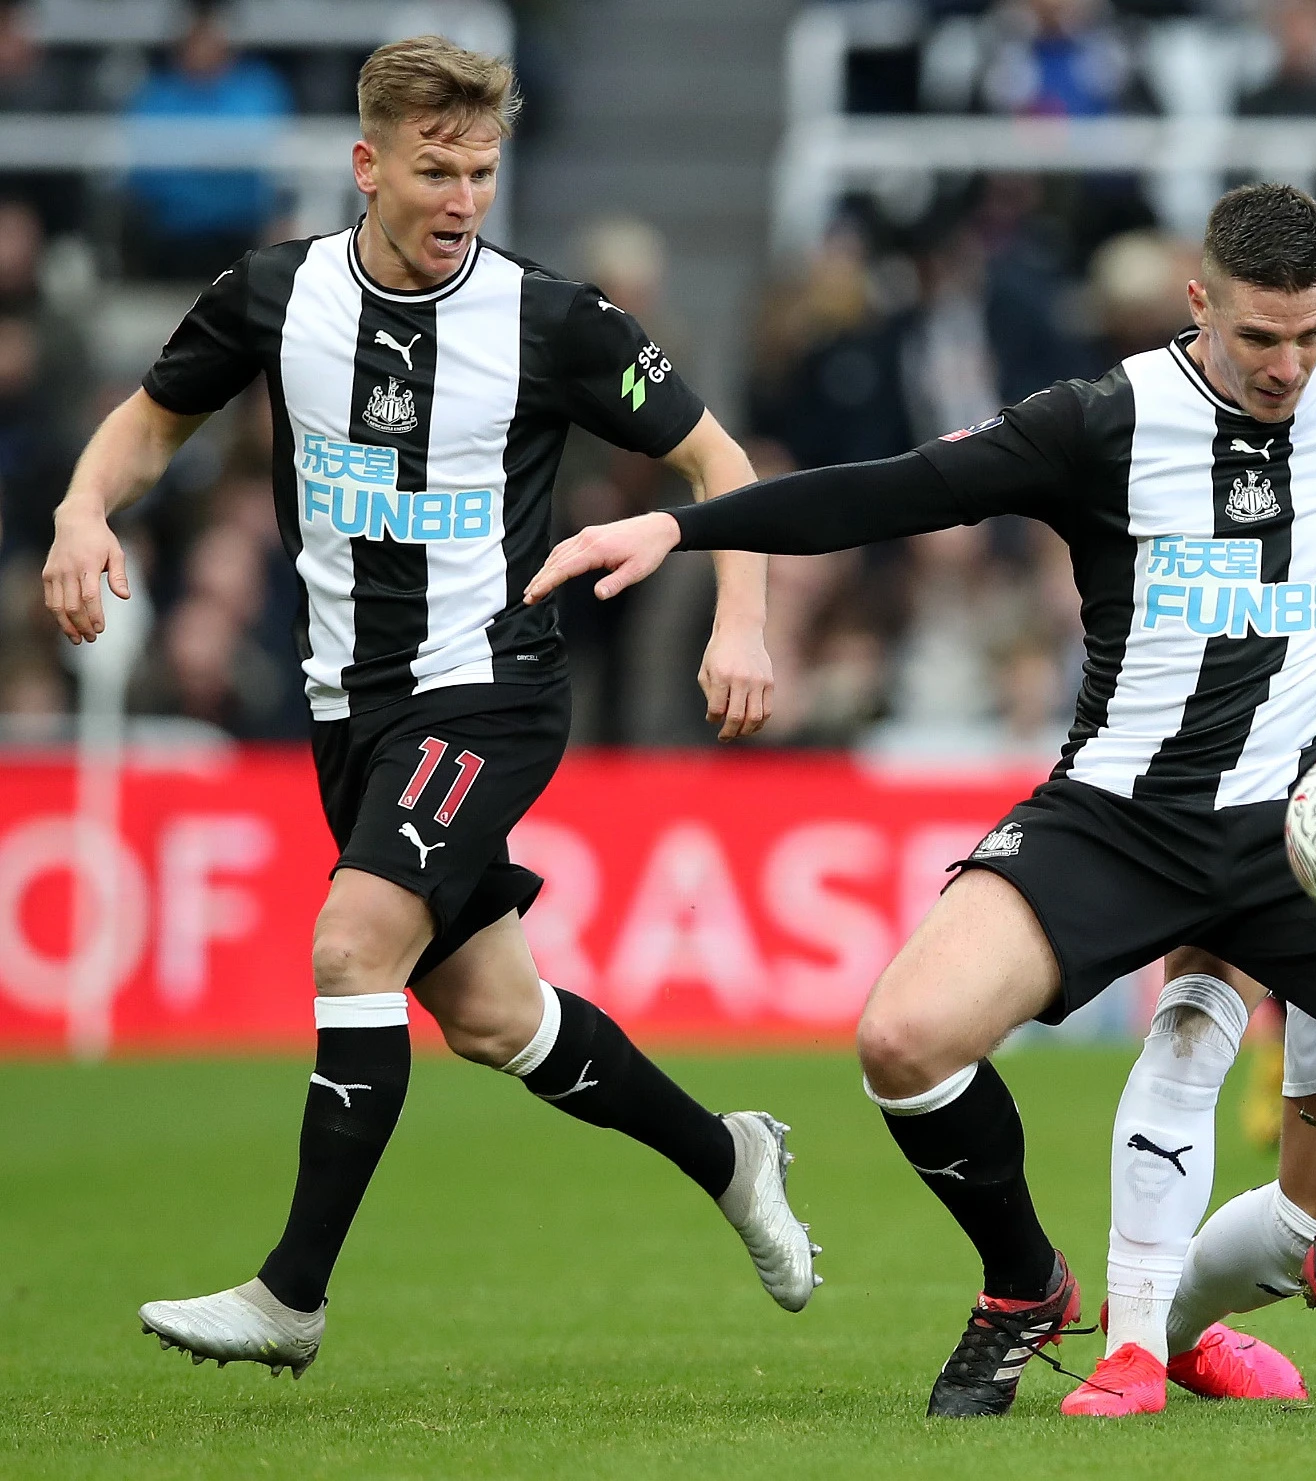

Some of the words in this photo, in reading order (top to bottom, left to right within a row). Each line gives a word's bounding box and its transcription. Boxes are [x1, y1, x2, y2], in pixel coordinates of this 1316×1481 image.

[302, 433, 396, 486] 乐天堂
[304, 479, 492, 541] FUN88
[1148, 535, 1259, 580] 乐天堂
[397, 736, 486, 828] 11
[0, 812, 278, 1018] OF
